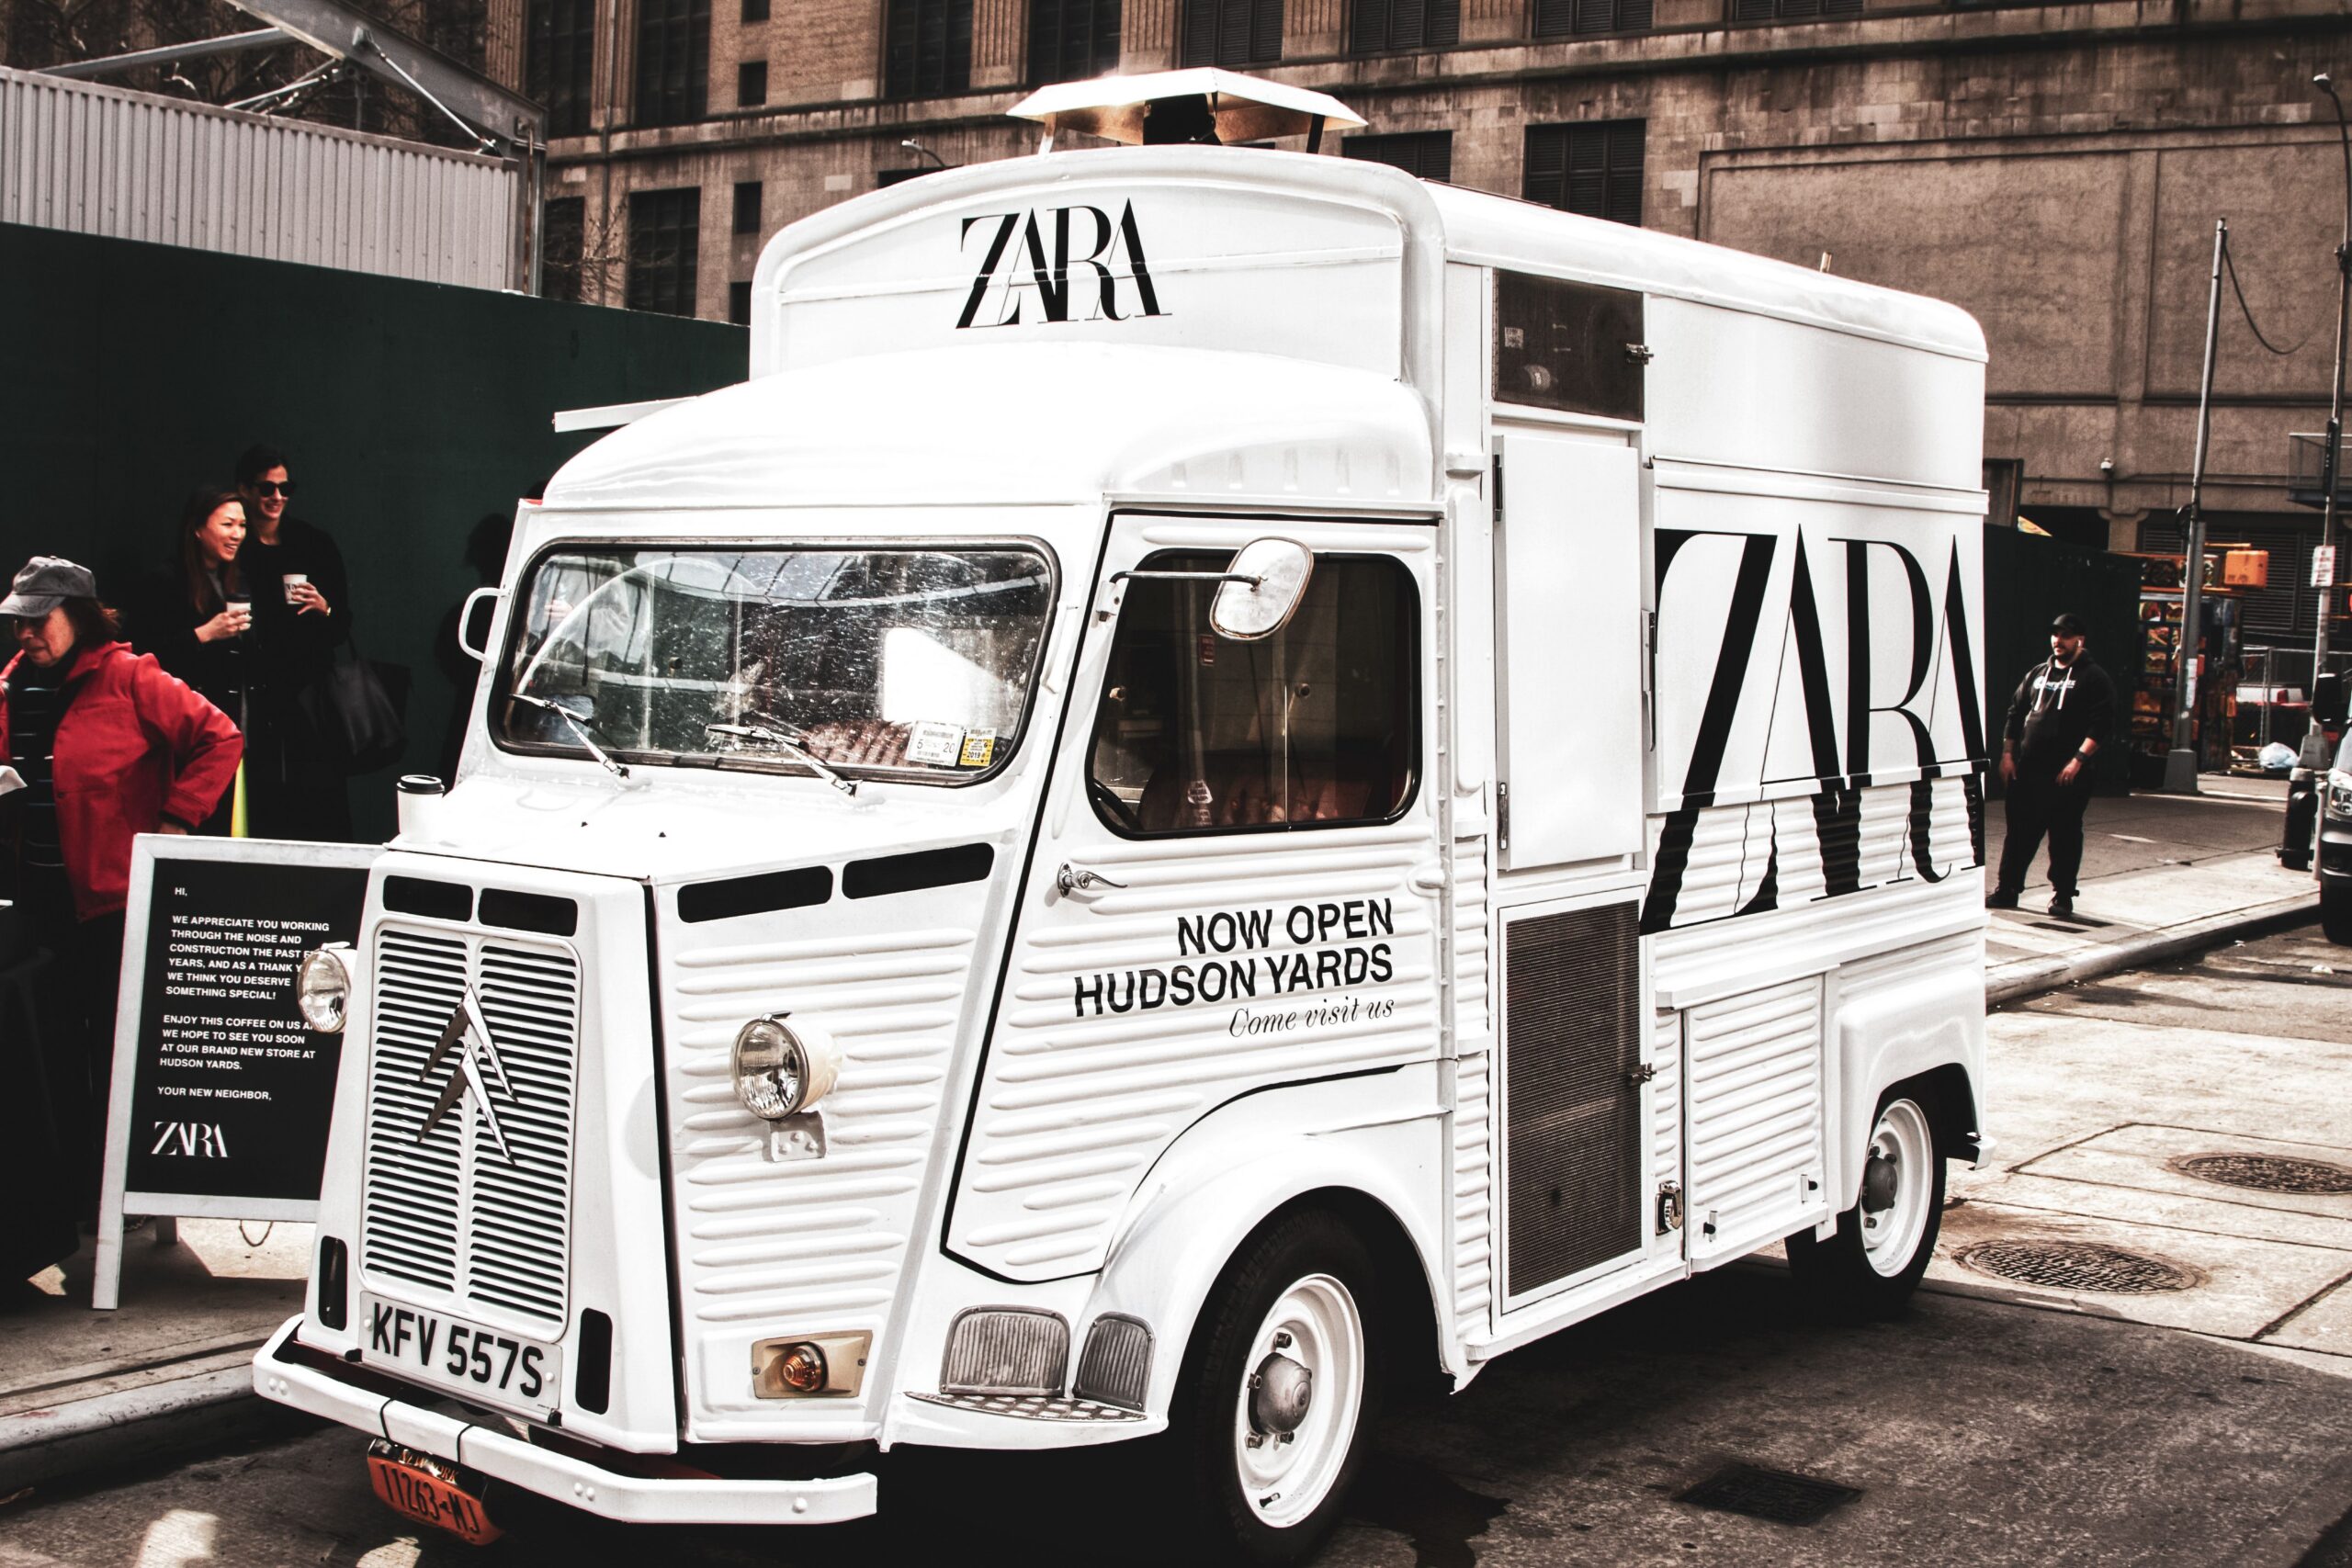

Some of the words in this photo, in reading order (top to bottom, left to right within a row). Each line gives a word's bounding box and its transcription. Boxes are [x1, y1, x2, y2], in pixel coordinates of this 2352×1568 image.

[956, 197, 1173, 329] ZARA
[1639, 523, 1991, 936] ZARA
[175, 886, 188, 897] HI,
[172, 915, 188, 924] WE
[190, 916, 254, 928] APPRECIATE
[256, 919, 278, 930] YOU
[280, 920, 330, 931] WORKING
[1177, 908, 1273, 956] NOW
[1286, 897, 1394, 945] OPEN
[171, 929, 222, 941] THROUGH
[223, 931, 244, 942] THE
[246, 932, 278, 943] NOISE
[279, 934, 302, 944] AND
[168, 942, 251, 955] CONSTRUCTION
[252, 947, 273, 957] THE
[274, 948, 302, 959] PAST
[168, 957, 206, 969] YEARS,
[207, 959, 231, 969] AND
[232, 961, 247, 971] AS
[247, 962, 256, 971] A
[257, 962, 293, 973] THANK
[166, 971, 184, 981] WE
[186, 972, 217, 983] THINK
[219, 974, 242, 985] YOU
[243, 976, 291, 987] DESERVE
[1074, 958, 1256, 1017] HUDSON
[1264, 942, 1393, 994] YARDS
[165, 986, 227, 998] SOMETHING
[229, 988, 277, 1000] SPECIAL!
[163, 1014, 198, 1024] ENJOY
[199, 1016, 223, 1026] THIS
[225, 1017, 266, 1029] COFFEE
[268, 1020, 285, 1029] ON
[286, 1021, 300, 1030] US
[1228, 1007, 1296, 1038] Come
[1305, 995, 1360, 1028] visit
[1367, 998, 1395, 1020] us
[162, 1029, 179, 1038] WE
[180, 1030, 210, 1040] HOPE
[211, 1031, 227, 1041] TO
[228, 1032, 250, 1042] SEE
[251, 1032, 274, 1043] YOU
[275, 1034, 306, 1044] SOON
[161, 1043, 175, 1052] AT
[175, 1043, 199, 1054] OUR
[201, 1044, 238, 1055] BRAND
[240, 1046, 265, 1056] NEW
[266, 1048, 301, 1058] STORE
[301, 1050, 316, 1059] AT
[159, 1057, 204, 1068] HUDSON
[205, 1059, 243, 1070] YARDS.
[157, 1086, 187, 1096] YOUR
[188, 1088, 213, 1098] NEW
[214, 1089, 272, 1101] NEIGHBOR,
[151, 1121, 230, 1158] ZARA
[372, 1302, 437, 1366] KFV
[447, 1325, 545, 1399] 557S
